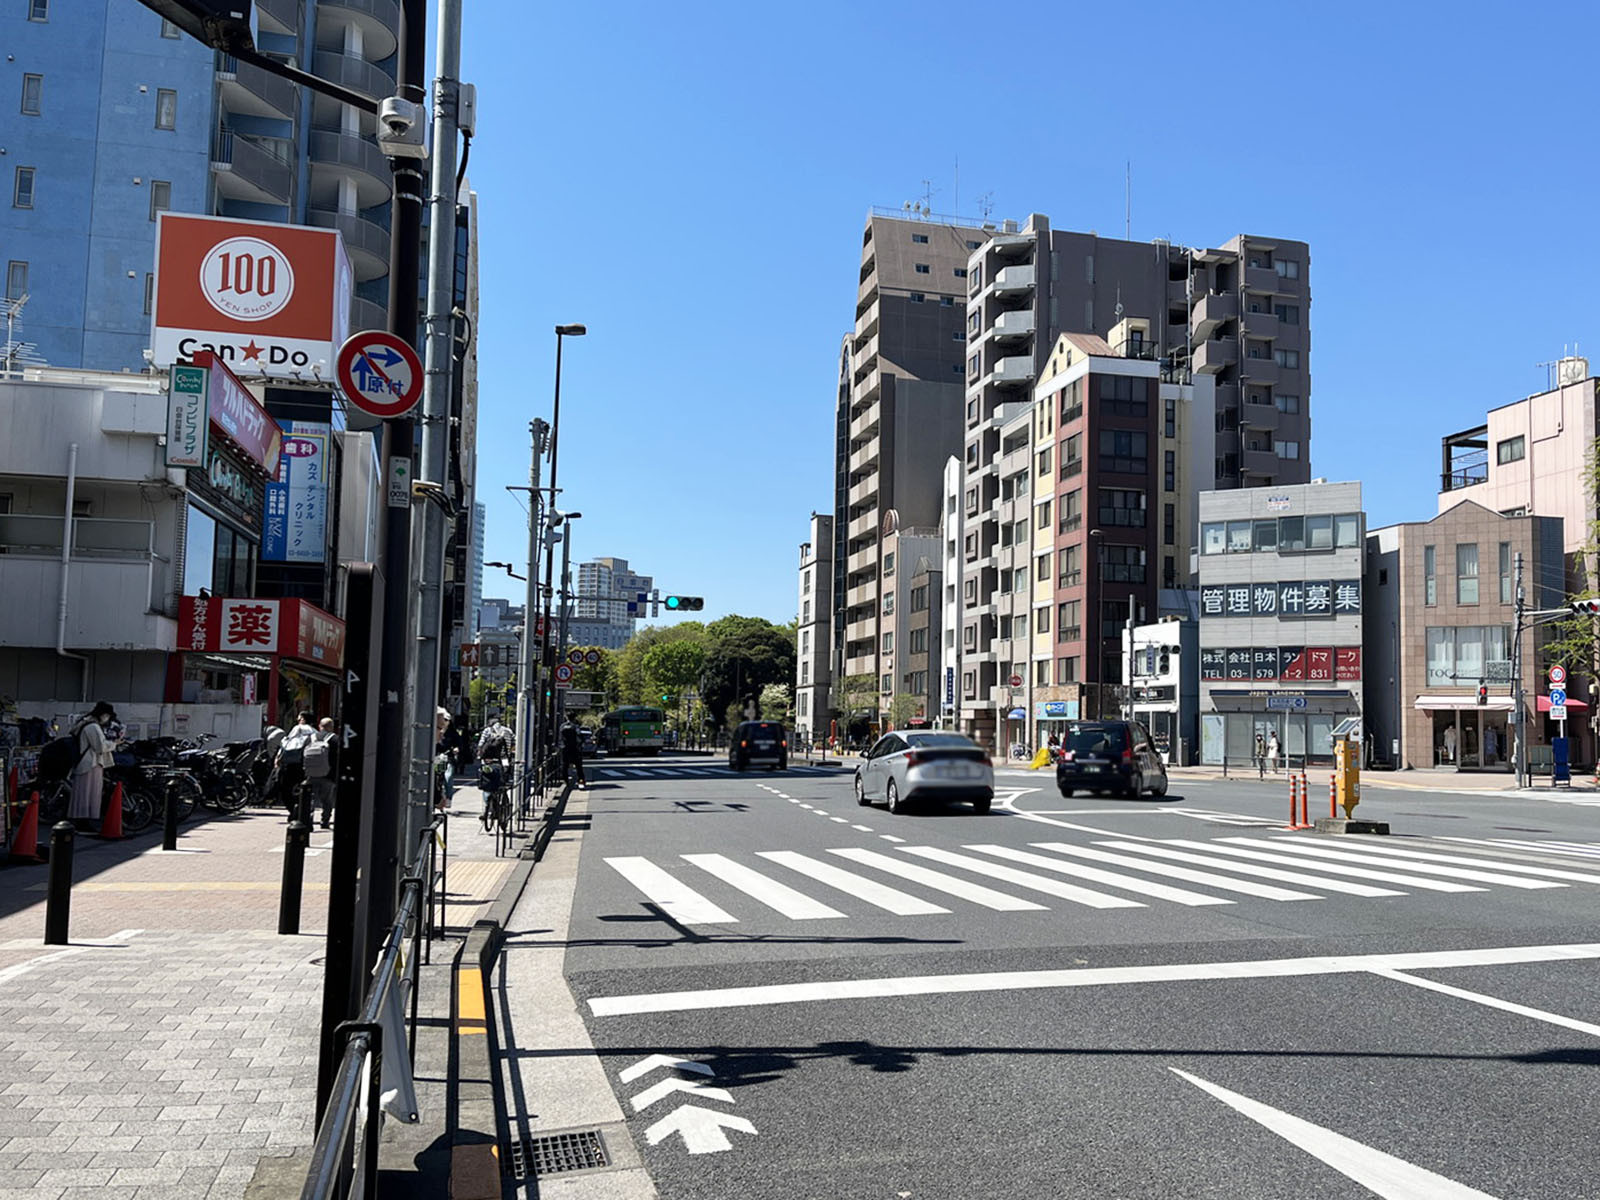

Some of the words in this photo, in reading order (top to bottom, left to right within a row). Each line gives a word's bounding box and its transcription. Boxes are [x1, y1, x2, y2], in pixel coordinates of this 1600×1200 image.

[217, 252, 277, 297] 100
[219, 297, 241, 313] YEN
[243, 300, 273, 314] SHOP
[270, 345, 309, 367] Do
[367, 376, 404, 397] 原付
[285, 442, 314, 455] 歯科
[293, 502, 304, 547] クリニック
[1202, 584, 1360, 613] 管理物件募集
[192, 598, 208, 650] 処方せん受付
[227, 604, 273, 646] 薬
[1204, 670, 1223, 679] TEL
